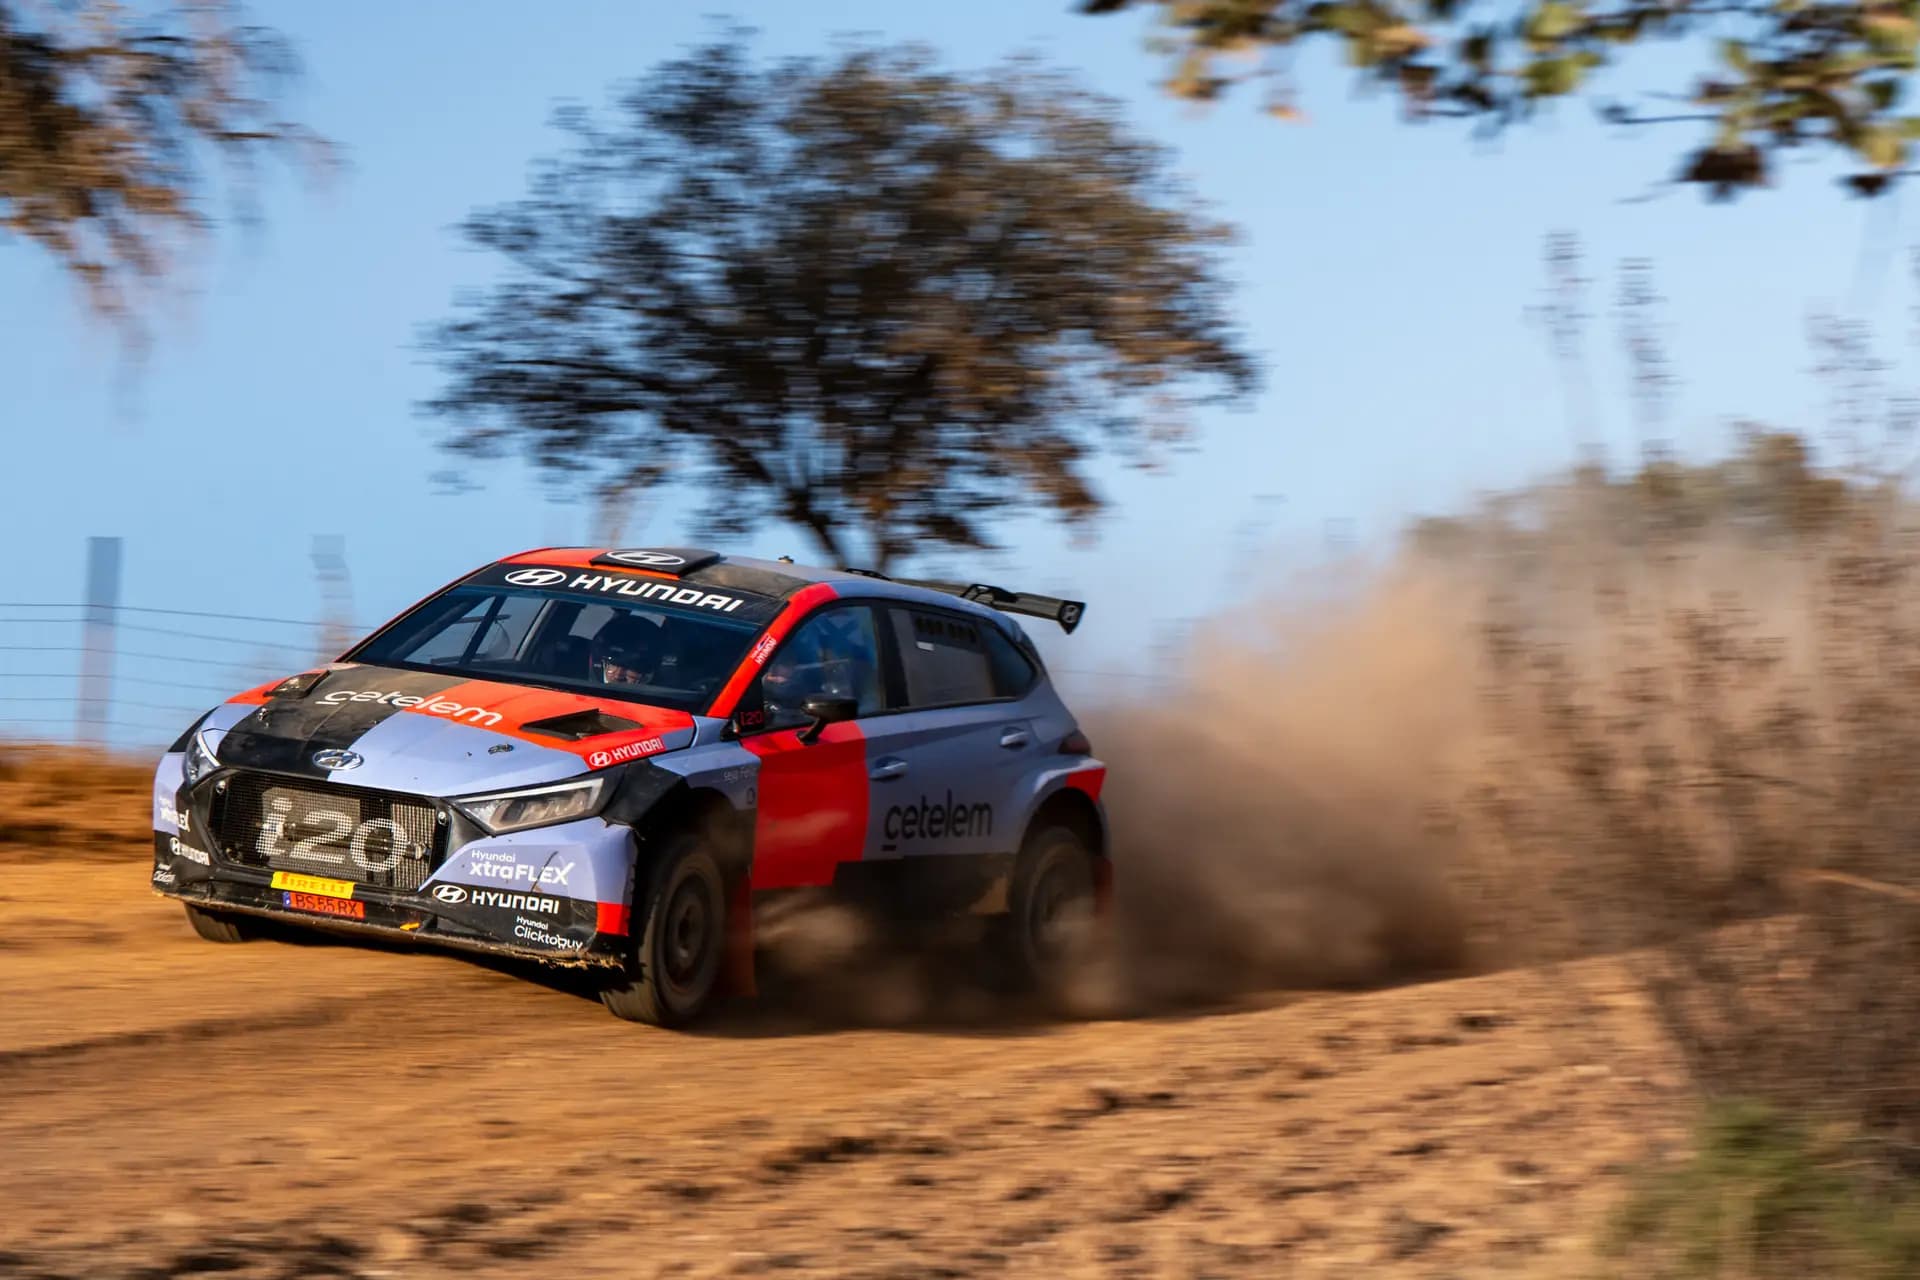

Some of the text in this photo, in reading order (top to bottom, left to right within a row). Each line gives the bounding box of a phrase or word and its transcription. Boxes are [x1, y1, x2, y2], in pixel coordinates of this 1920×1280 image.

[568, 574, 744, 612] HYUNDAI
[317, 690, 503, 726] cetelem
[611, 737, 664, 760] HYUNDAI
[883, 788, 992, 840] cetelem
[255, 797, 408, 872] i20
[471, 850, 516, 863] Hyundai
[469, 861, 576, 885] xtraFLEX
[471, 890, 560, 915] HYUNDAI
[516, 915, 549, 931] Hyundai
